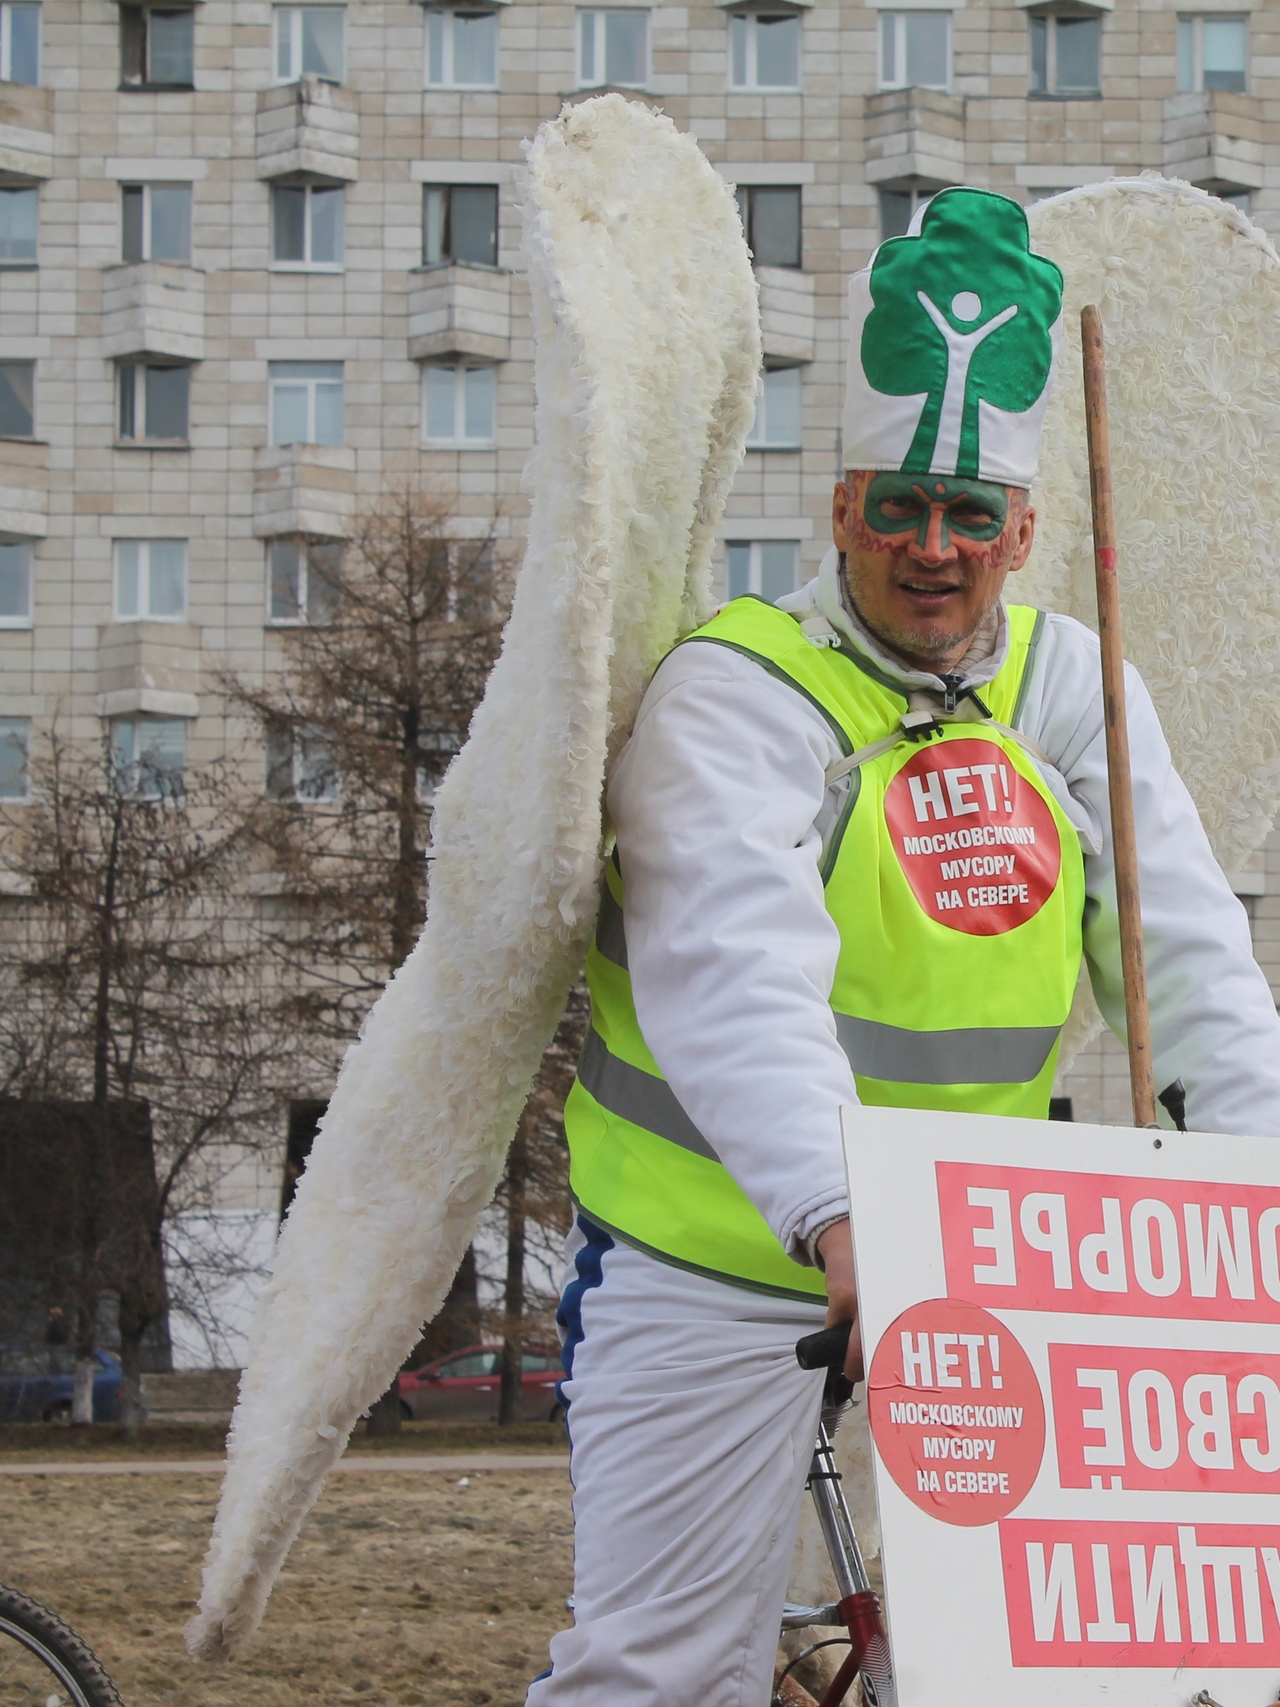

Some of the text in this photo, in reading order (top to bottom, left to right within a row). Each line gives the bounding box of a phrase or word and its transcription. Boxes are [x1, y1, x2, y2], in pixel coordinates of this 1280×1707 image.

[907, 764, 1013, 823] НЕТ!
[902, 827, 1036, 855] МОСКОВСКОМУ
[940, 855, 1016, 881] МУСОРУ
[935, 884, 1029, 911] НА СЕВЕРЕ
[900, 1331, 1003, 1389] НЕТ!
[889, 1402, 1024, 1429] МОСКОВСКОМУ
[922, 1436, 996, 1461] МУСОРУ
[916, 1469, 1010, 1494] НА СЕВЕРЕ
